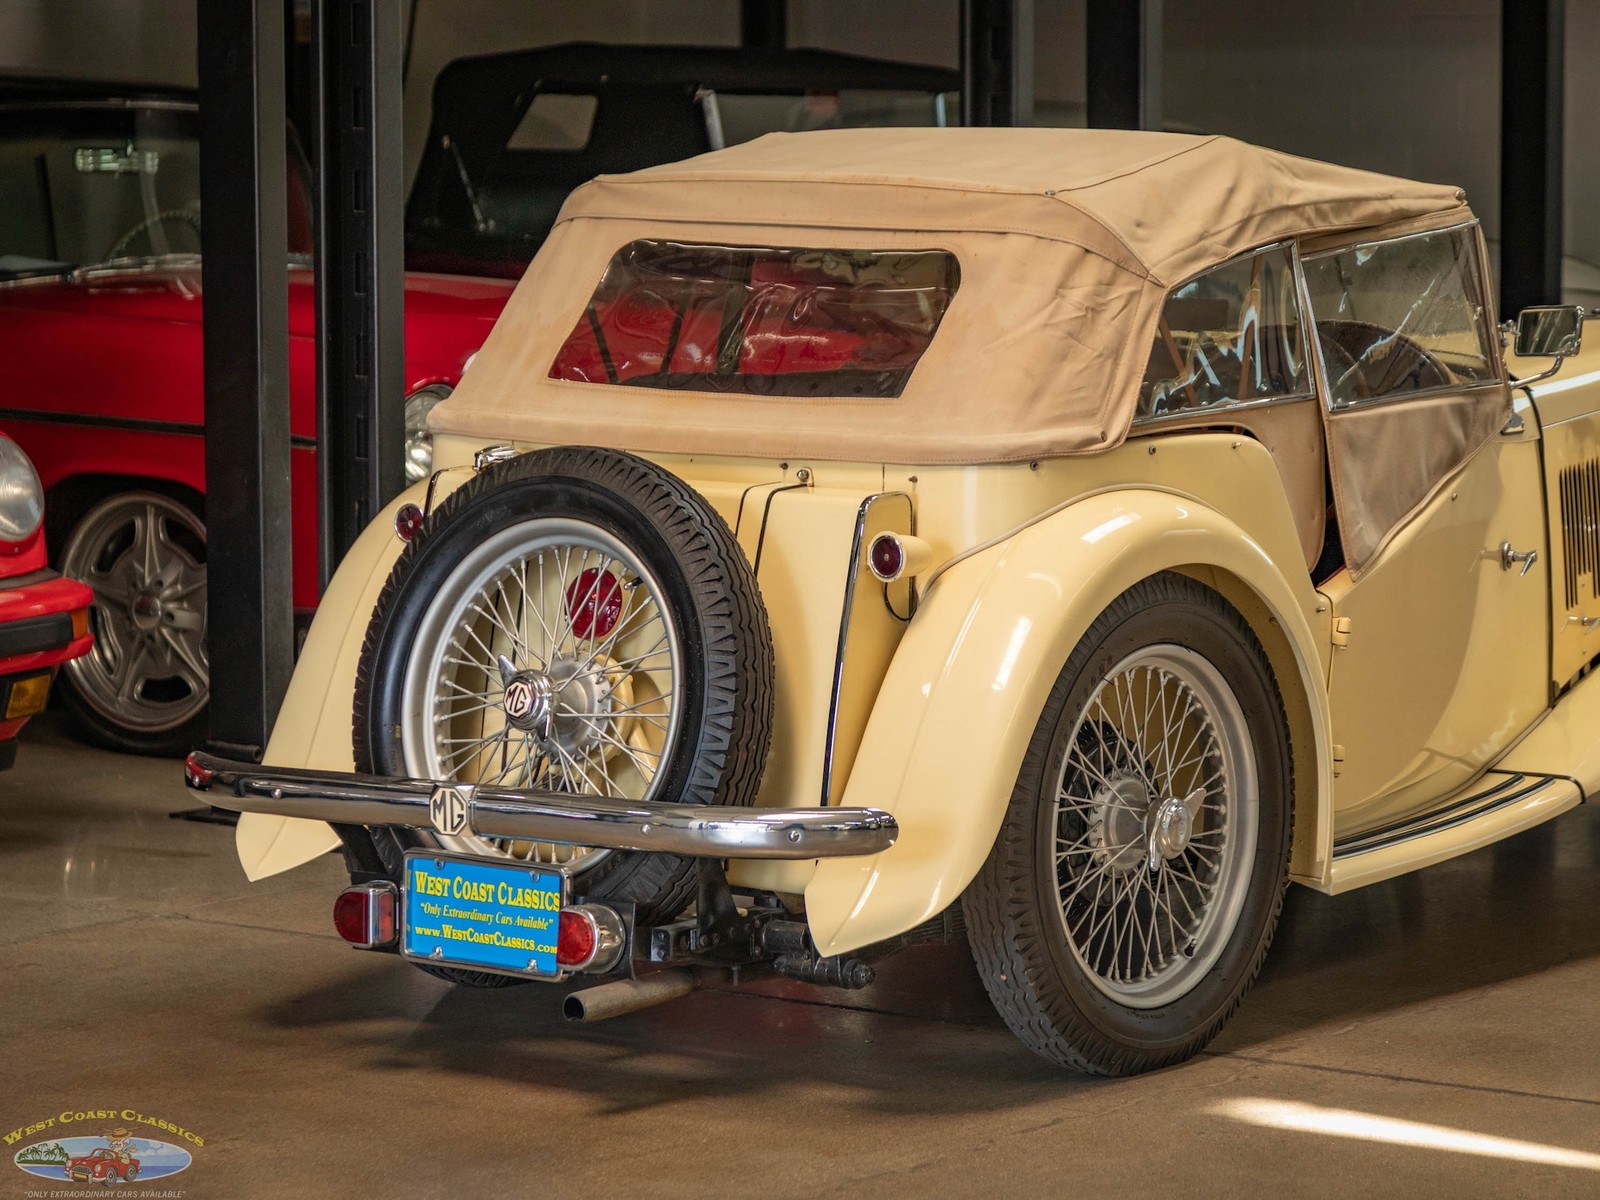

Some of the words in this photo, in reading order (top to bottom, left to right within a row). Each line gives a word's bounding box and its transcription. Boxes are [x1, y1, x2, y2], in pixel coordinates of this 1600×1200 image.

[505, 685, 527, 713] MG
[433, 790, 464, 832] MG
[443, 907, 494, 924] Extraordinary
[495, 912, 513, 925] Cars
